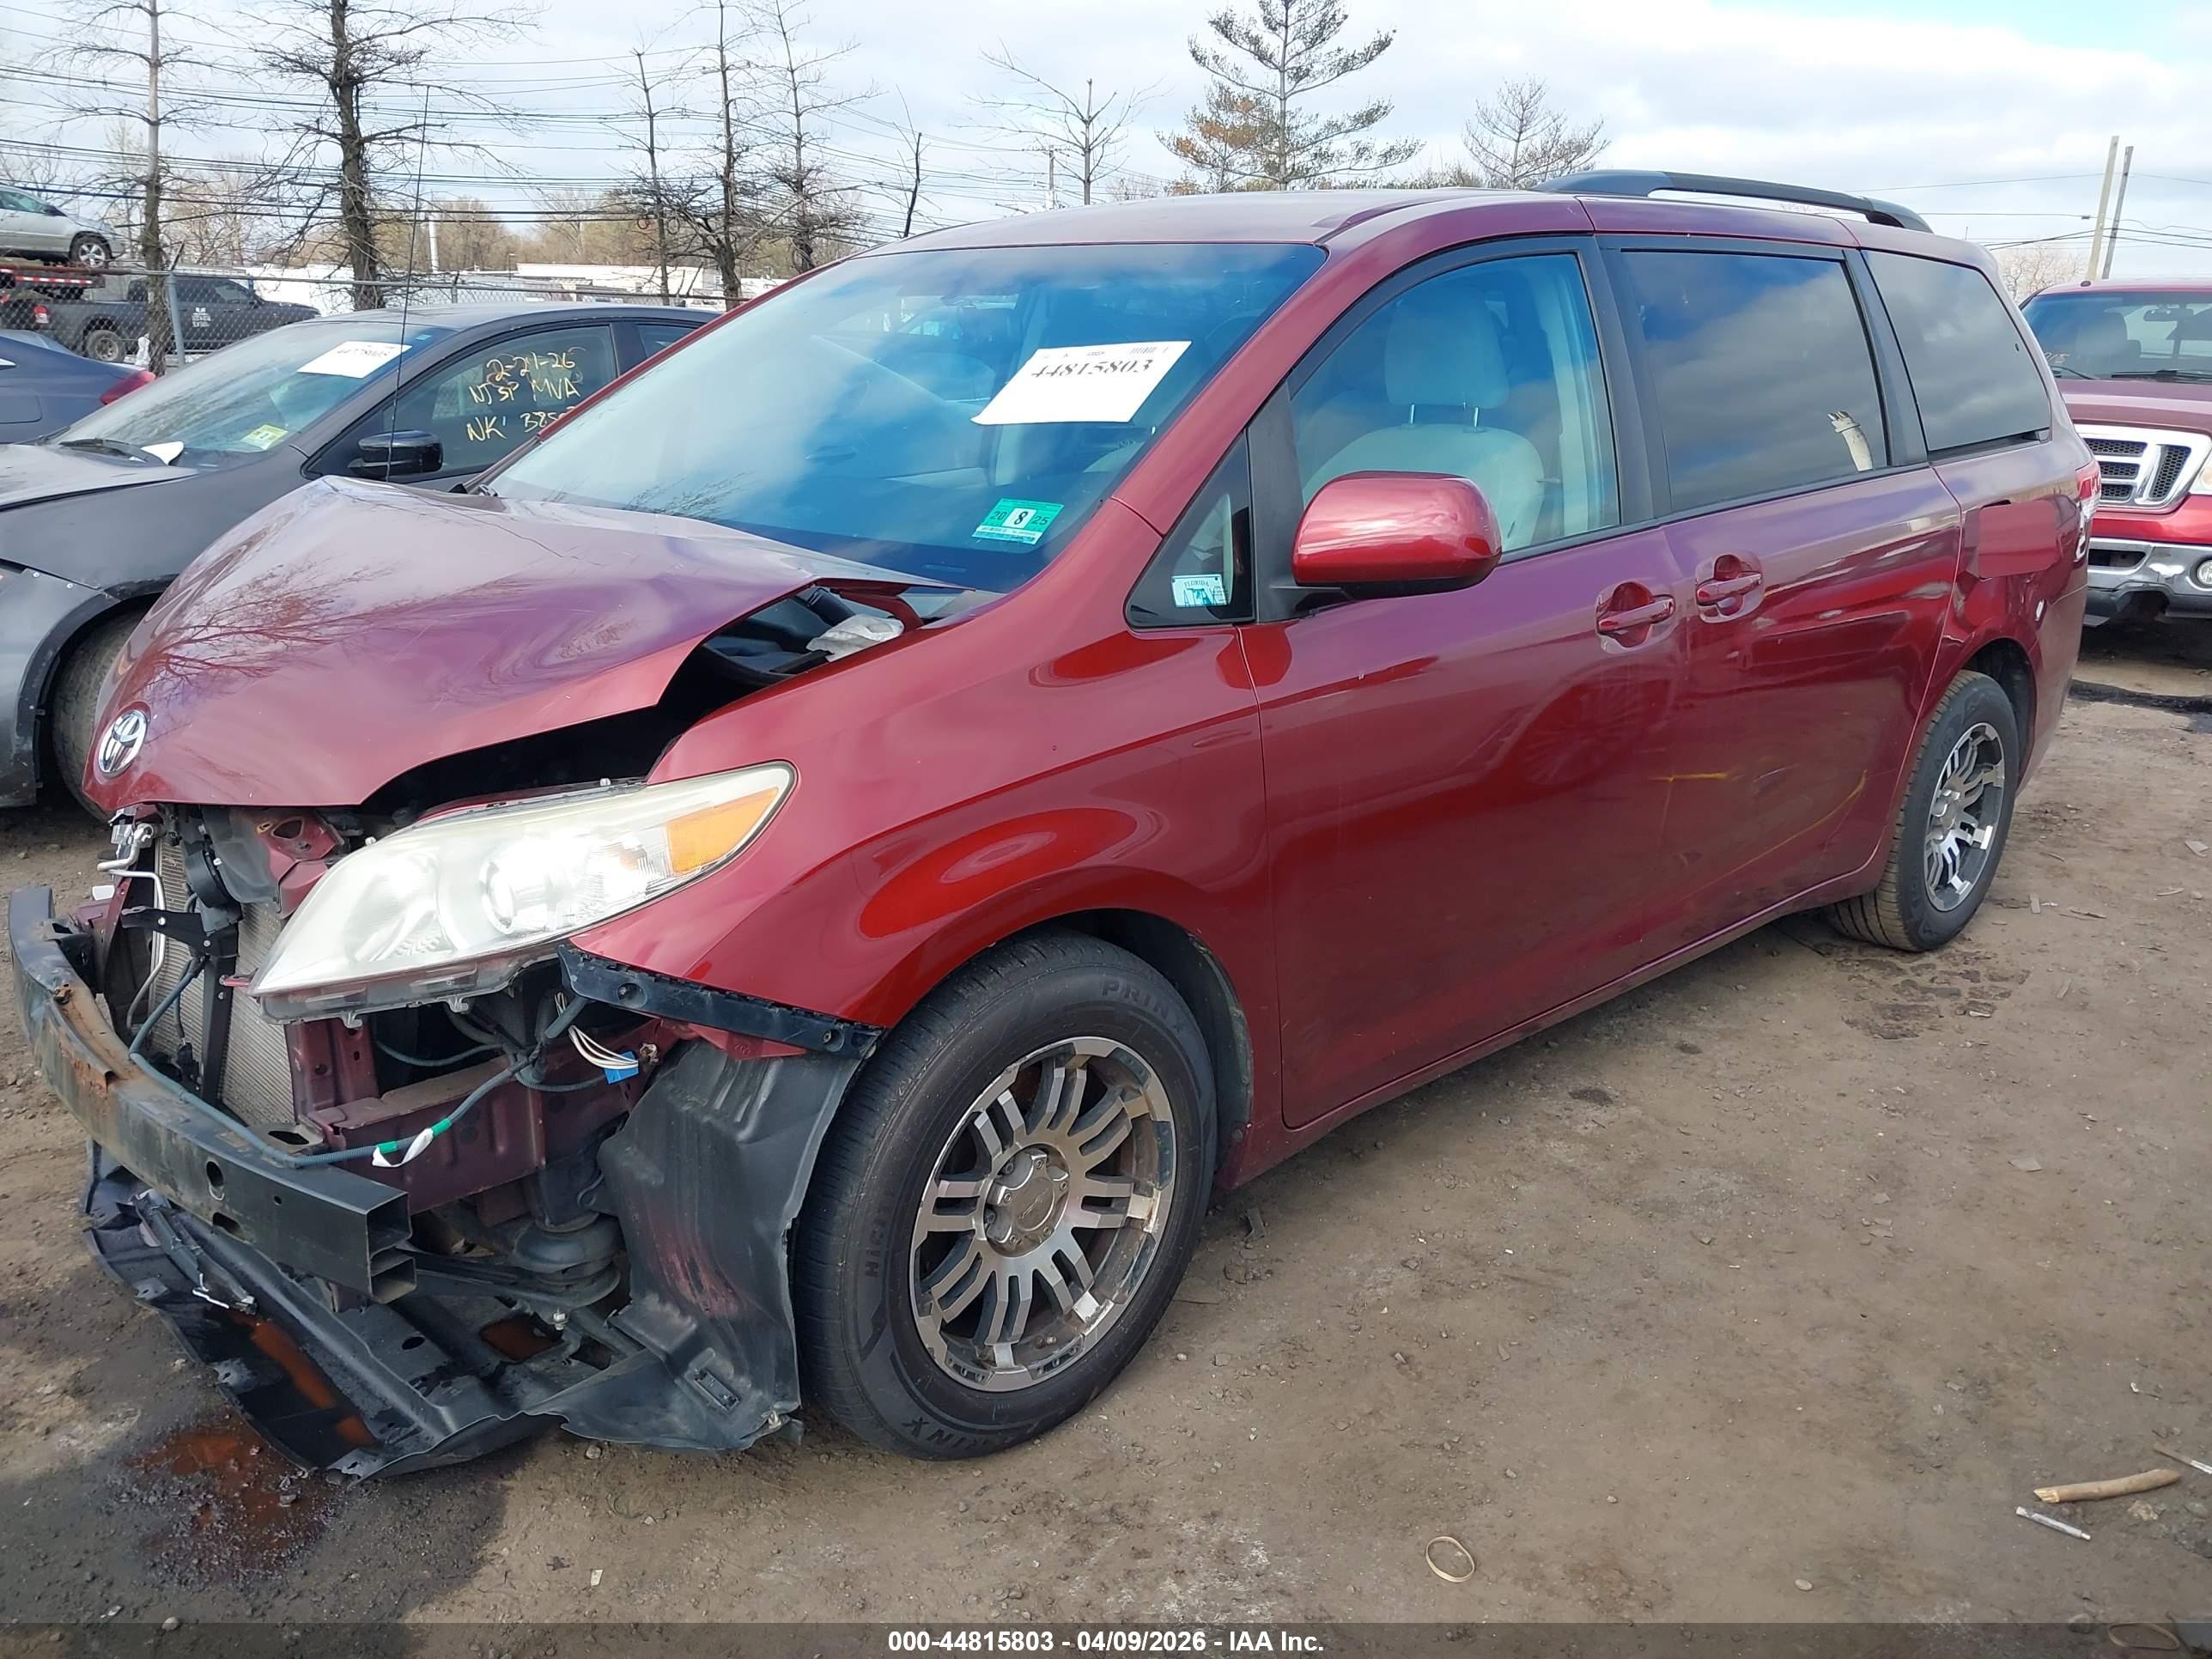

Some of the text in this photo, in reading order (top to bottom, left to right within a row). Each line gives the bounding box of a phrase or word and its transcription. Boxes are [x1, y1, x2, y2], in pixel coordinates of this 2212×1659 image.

[1031, 359, 1154, 378] 44815803
[989, 510, 1051, 526] 20 8 25
[1102, 977, 1183, 1035] PRINX
